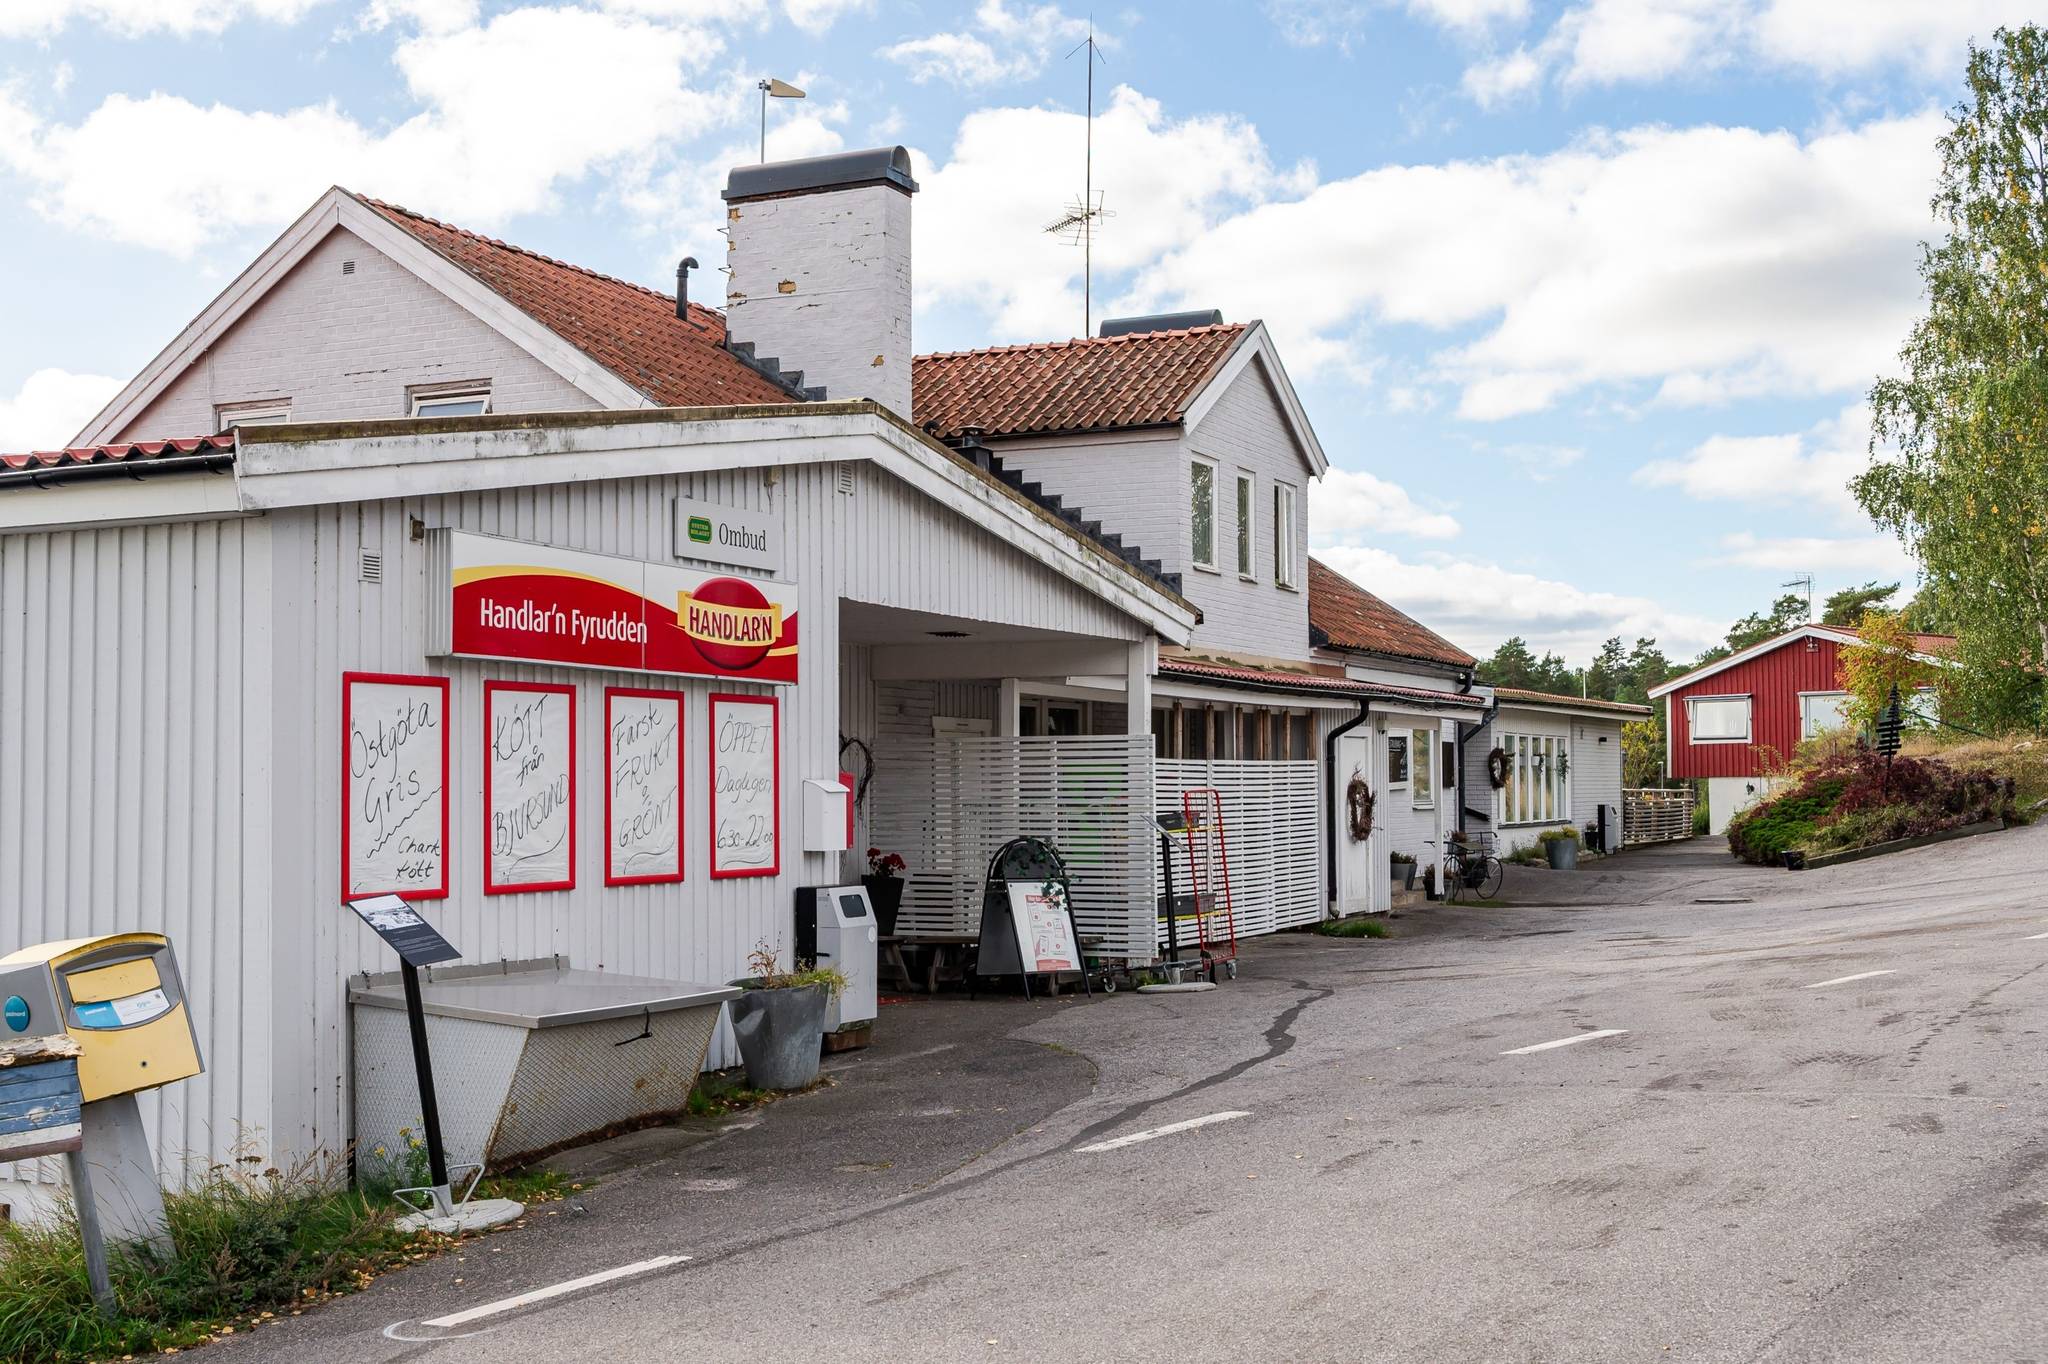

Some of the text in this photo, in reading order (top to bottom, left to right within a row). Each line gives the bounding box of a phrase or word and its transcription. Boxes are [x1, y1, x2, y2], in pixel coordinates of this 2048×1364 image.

[719, 523, 767, 552] Ombud
[480, 598, 648, 645] Handlar'n Fyrudden
[350, 697, 437, 783] Östgöta
[492, 694, 548, 762] KÖTT
[719, 713, 772, 753] ÖPPET
[516, 744, 545, 788] från
[616, 723, 677, 798] FRUKT
[365, 770, 421, 841] Gris
[619, 785, 677, 847] GRÖNT
